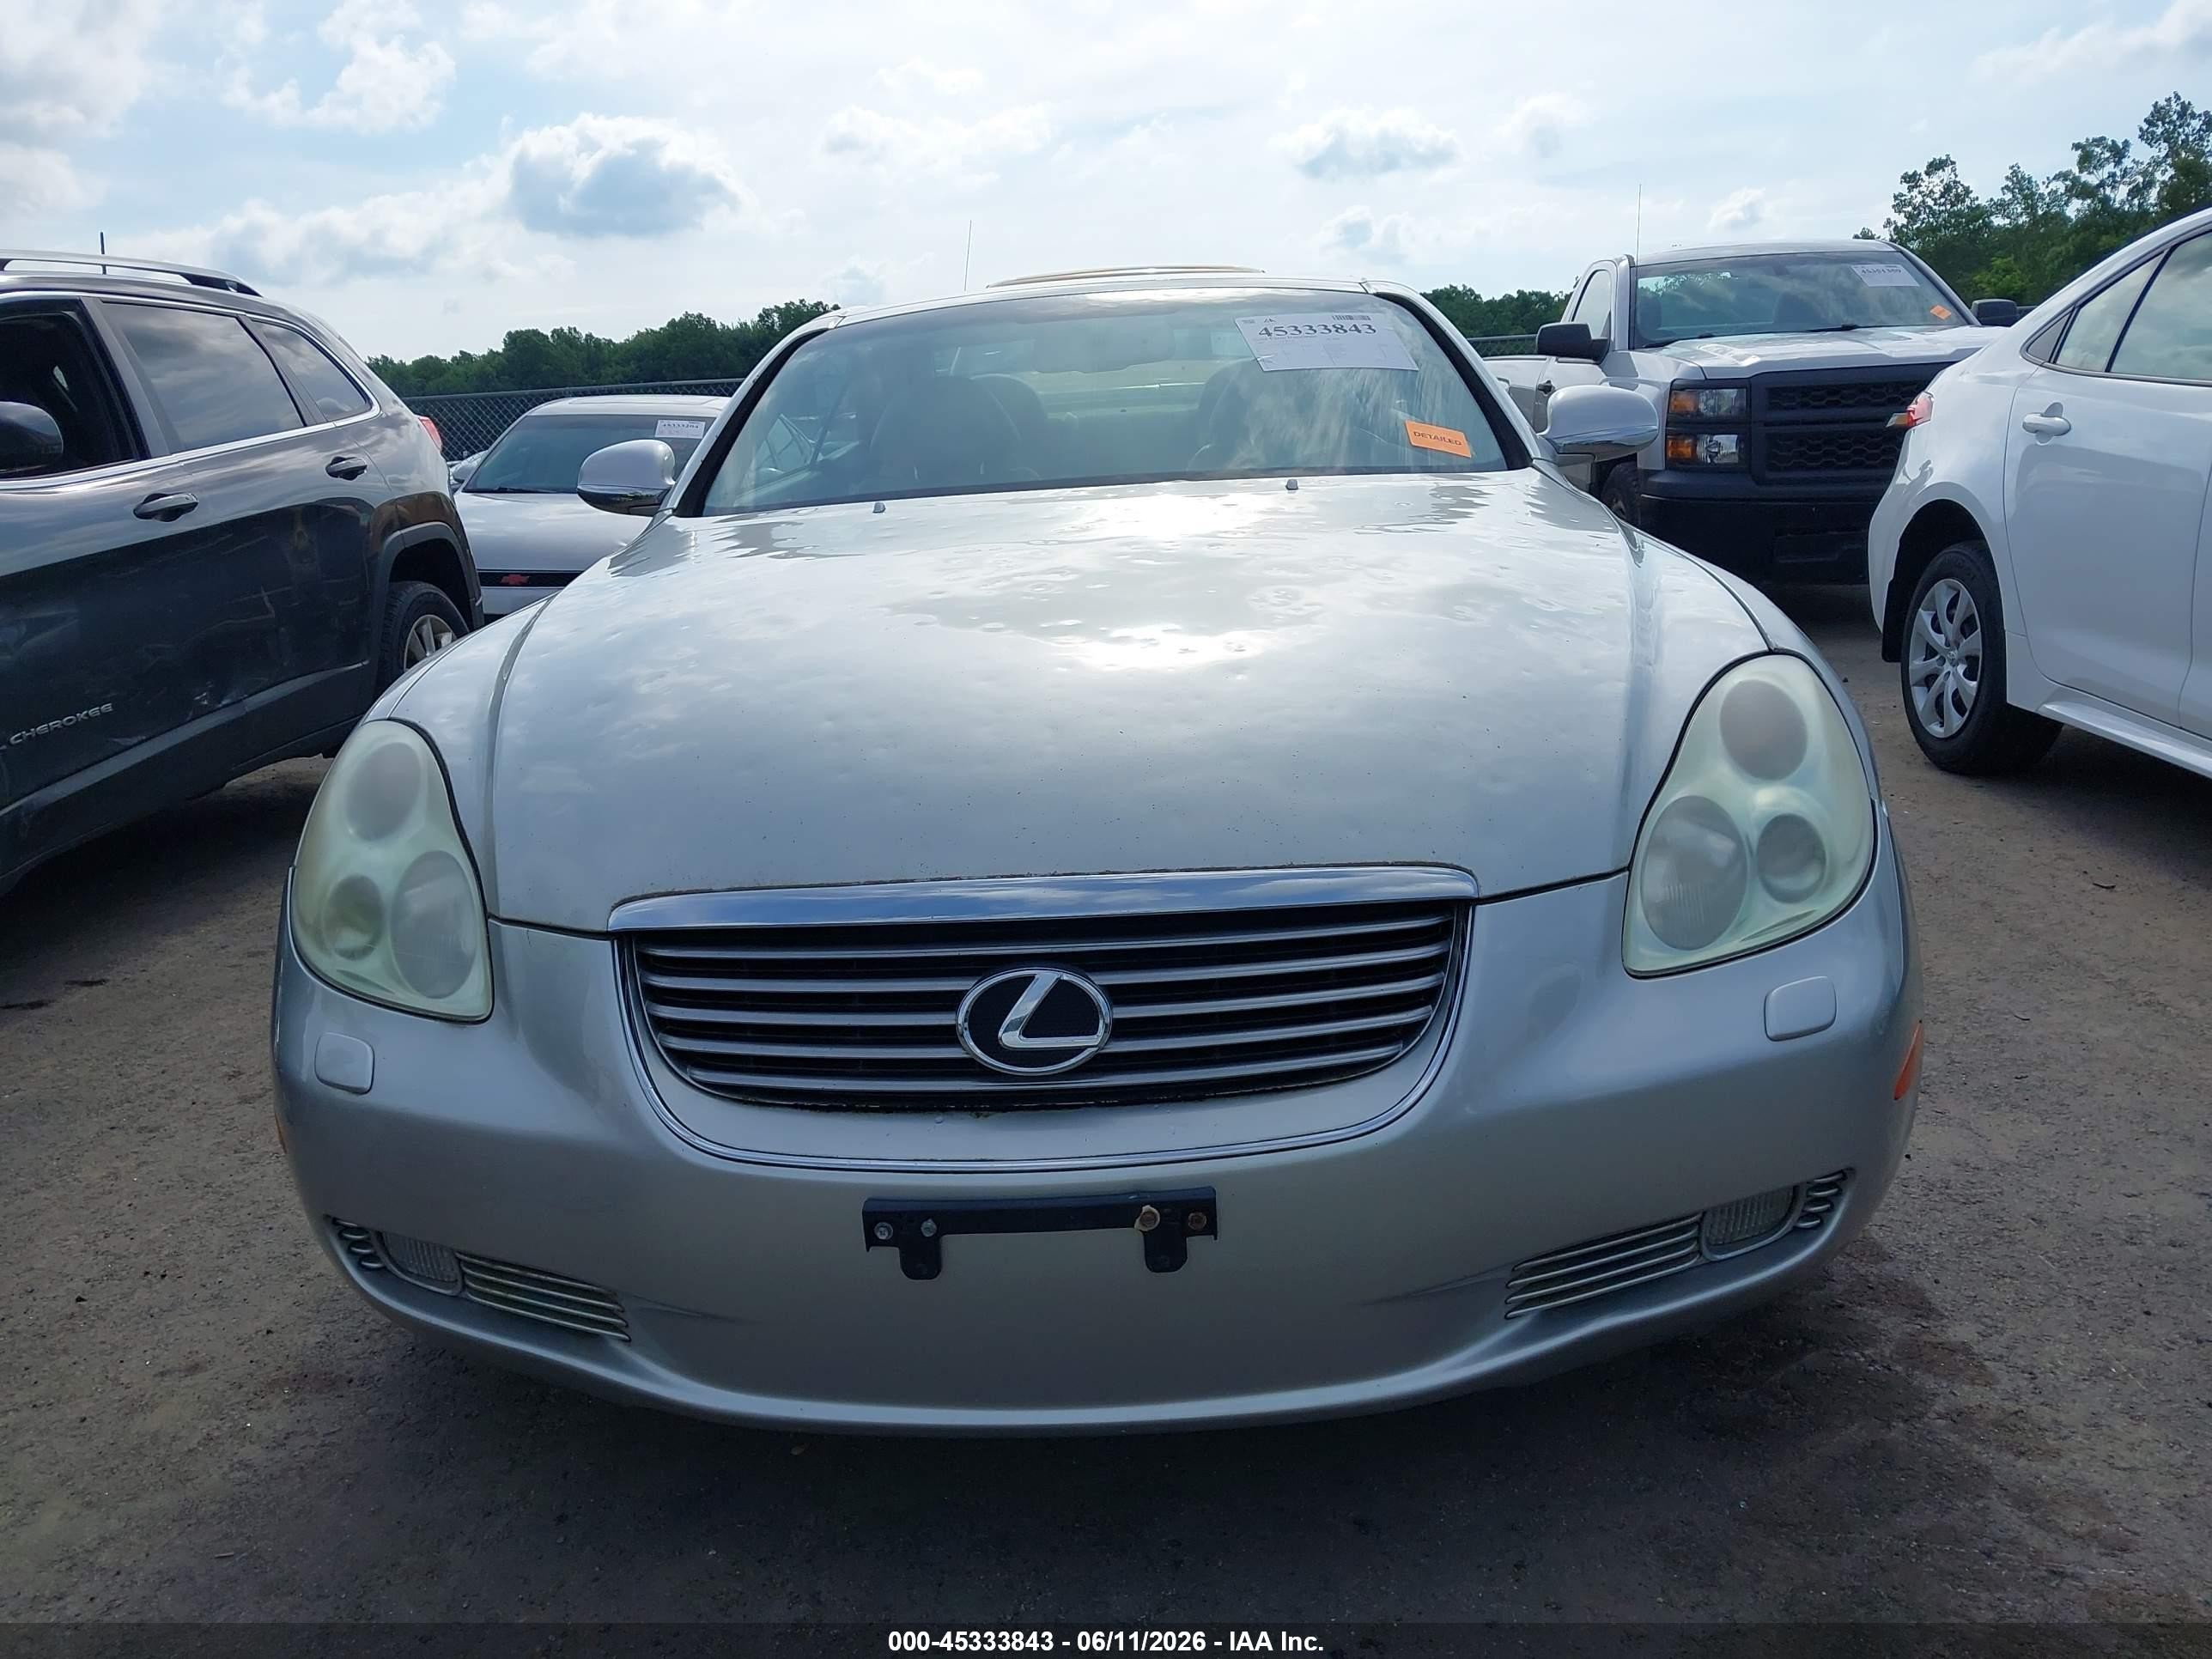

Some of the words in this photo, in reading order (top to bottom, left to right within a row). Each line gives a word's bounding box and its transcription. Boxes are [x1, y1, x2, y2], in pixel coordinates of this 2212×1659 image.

[1258, 323, 1377, 337] 45333843
[1413, 431, 1462, 446] DETAILED
[9, 702, 113, 744] CHEROKEE
